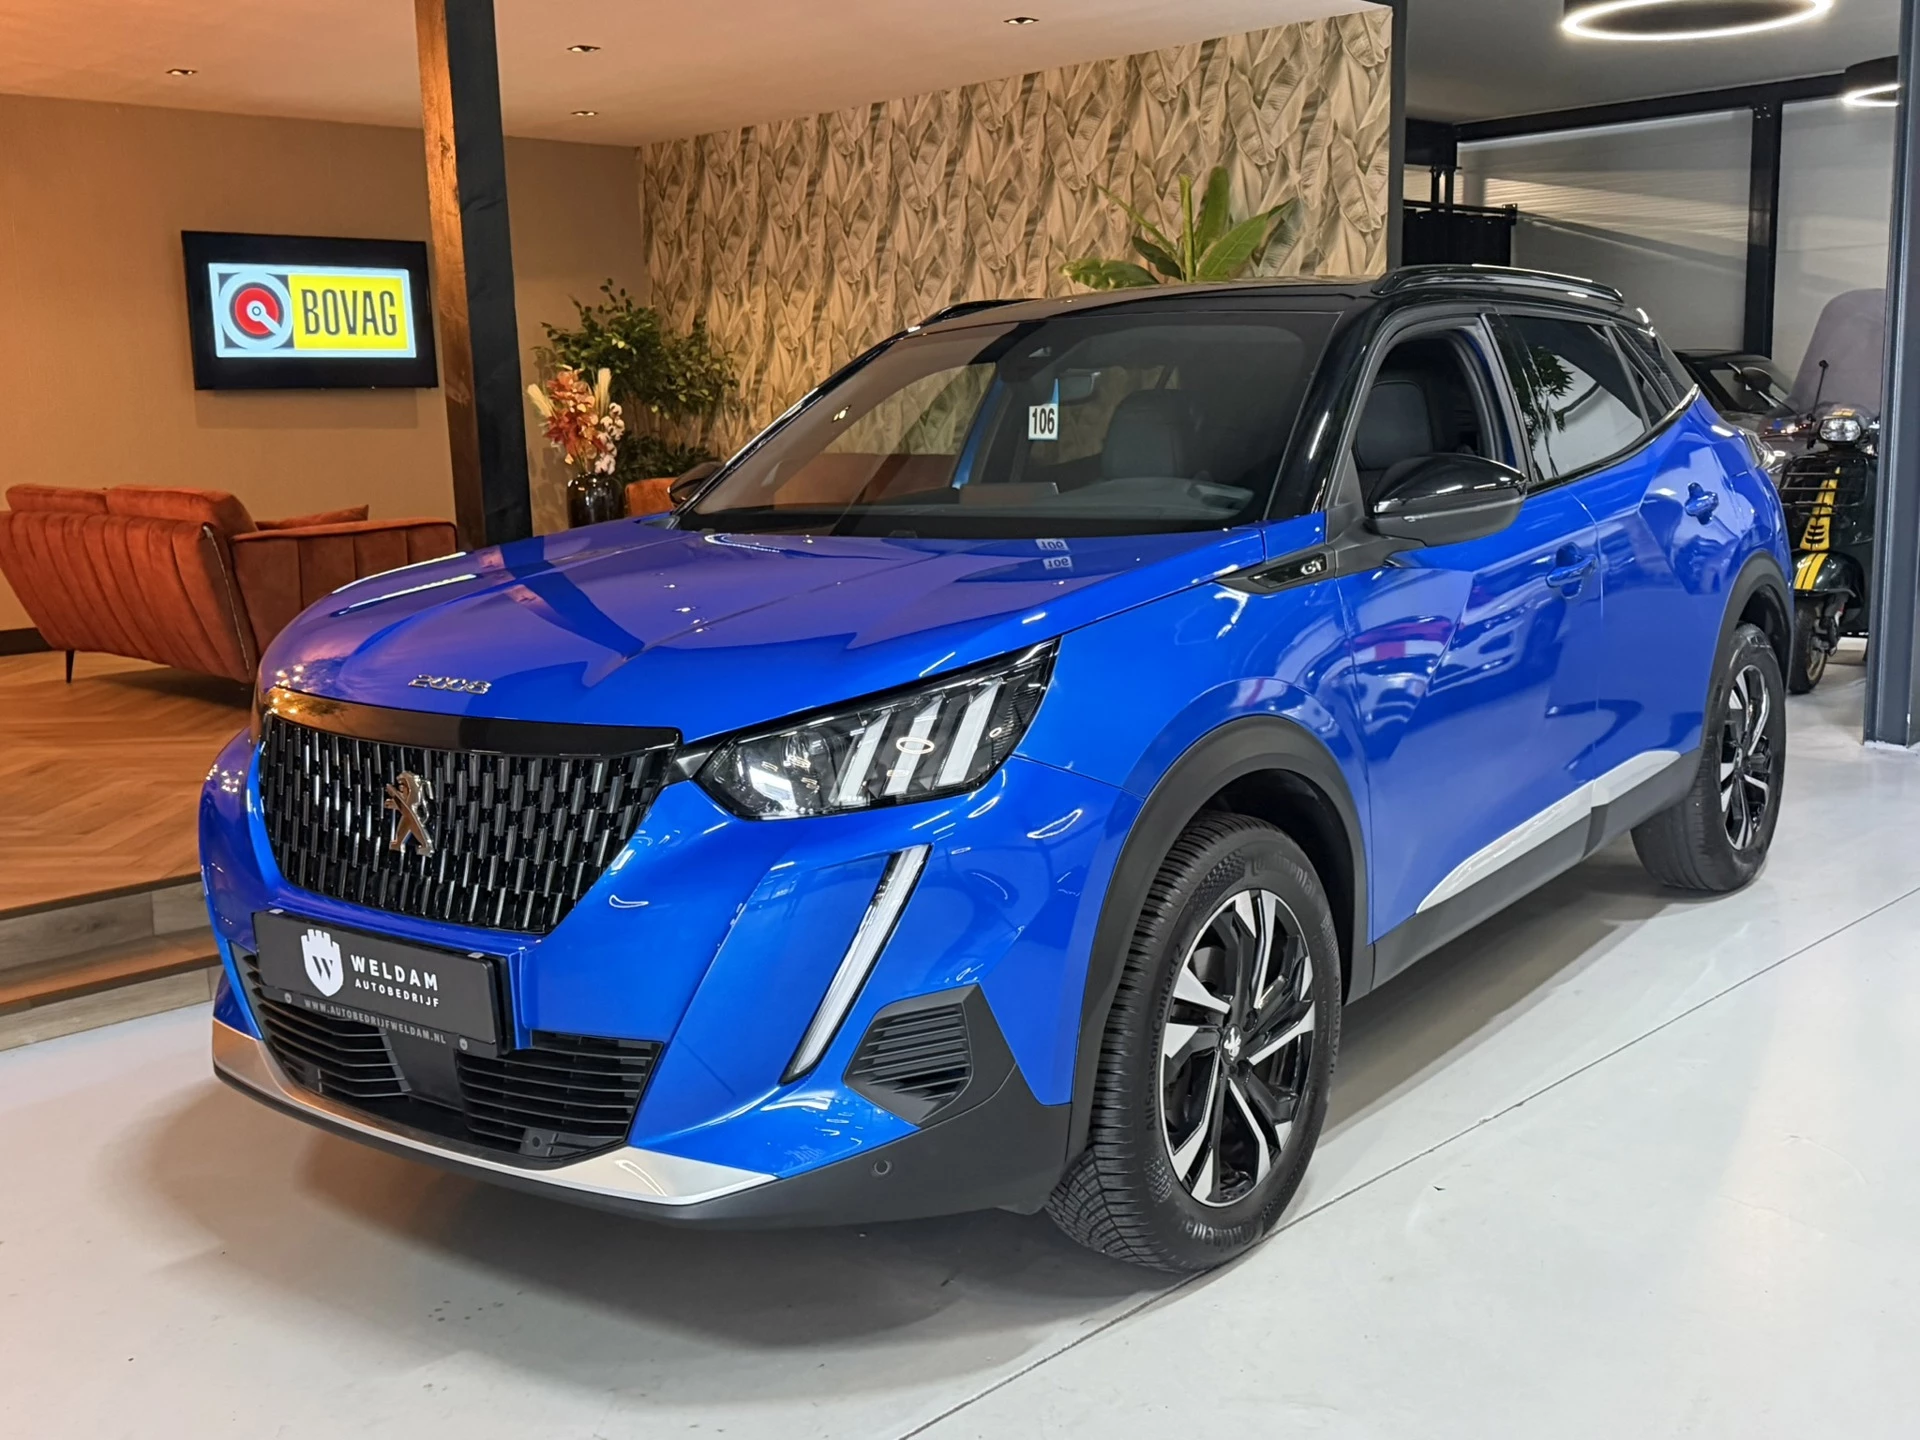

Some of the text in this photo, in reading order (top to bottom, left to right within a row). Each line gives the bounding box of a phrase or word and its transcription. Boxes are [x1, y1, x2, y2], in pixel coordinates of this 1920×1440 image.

[301, 288, 398, 336] BOVAG
[1031, 407, 1055, 435] 106
[408, 674, 492, 695] 2008
[350, 953, 439, 992] WELDAM
[354, 978, 440, 1008] AUTOBEDRIJF
[303, 999, 447, 1045] WWW.AUTOBEDRIJFWELDAM.NL
